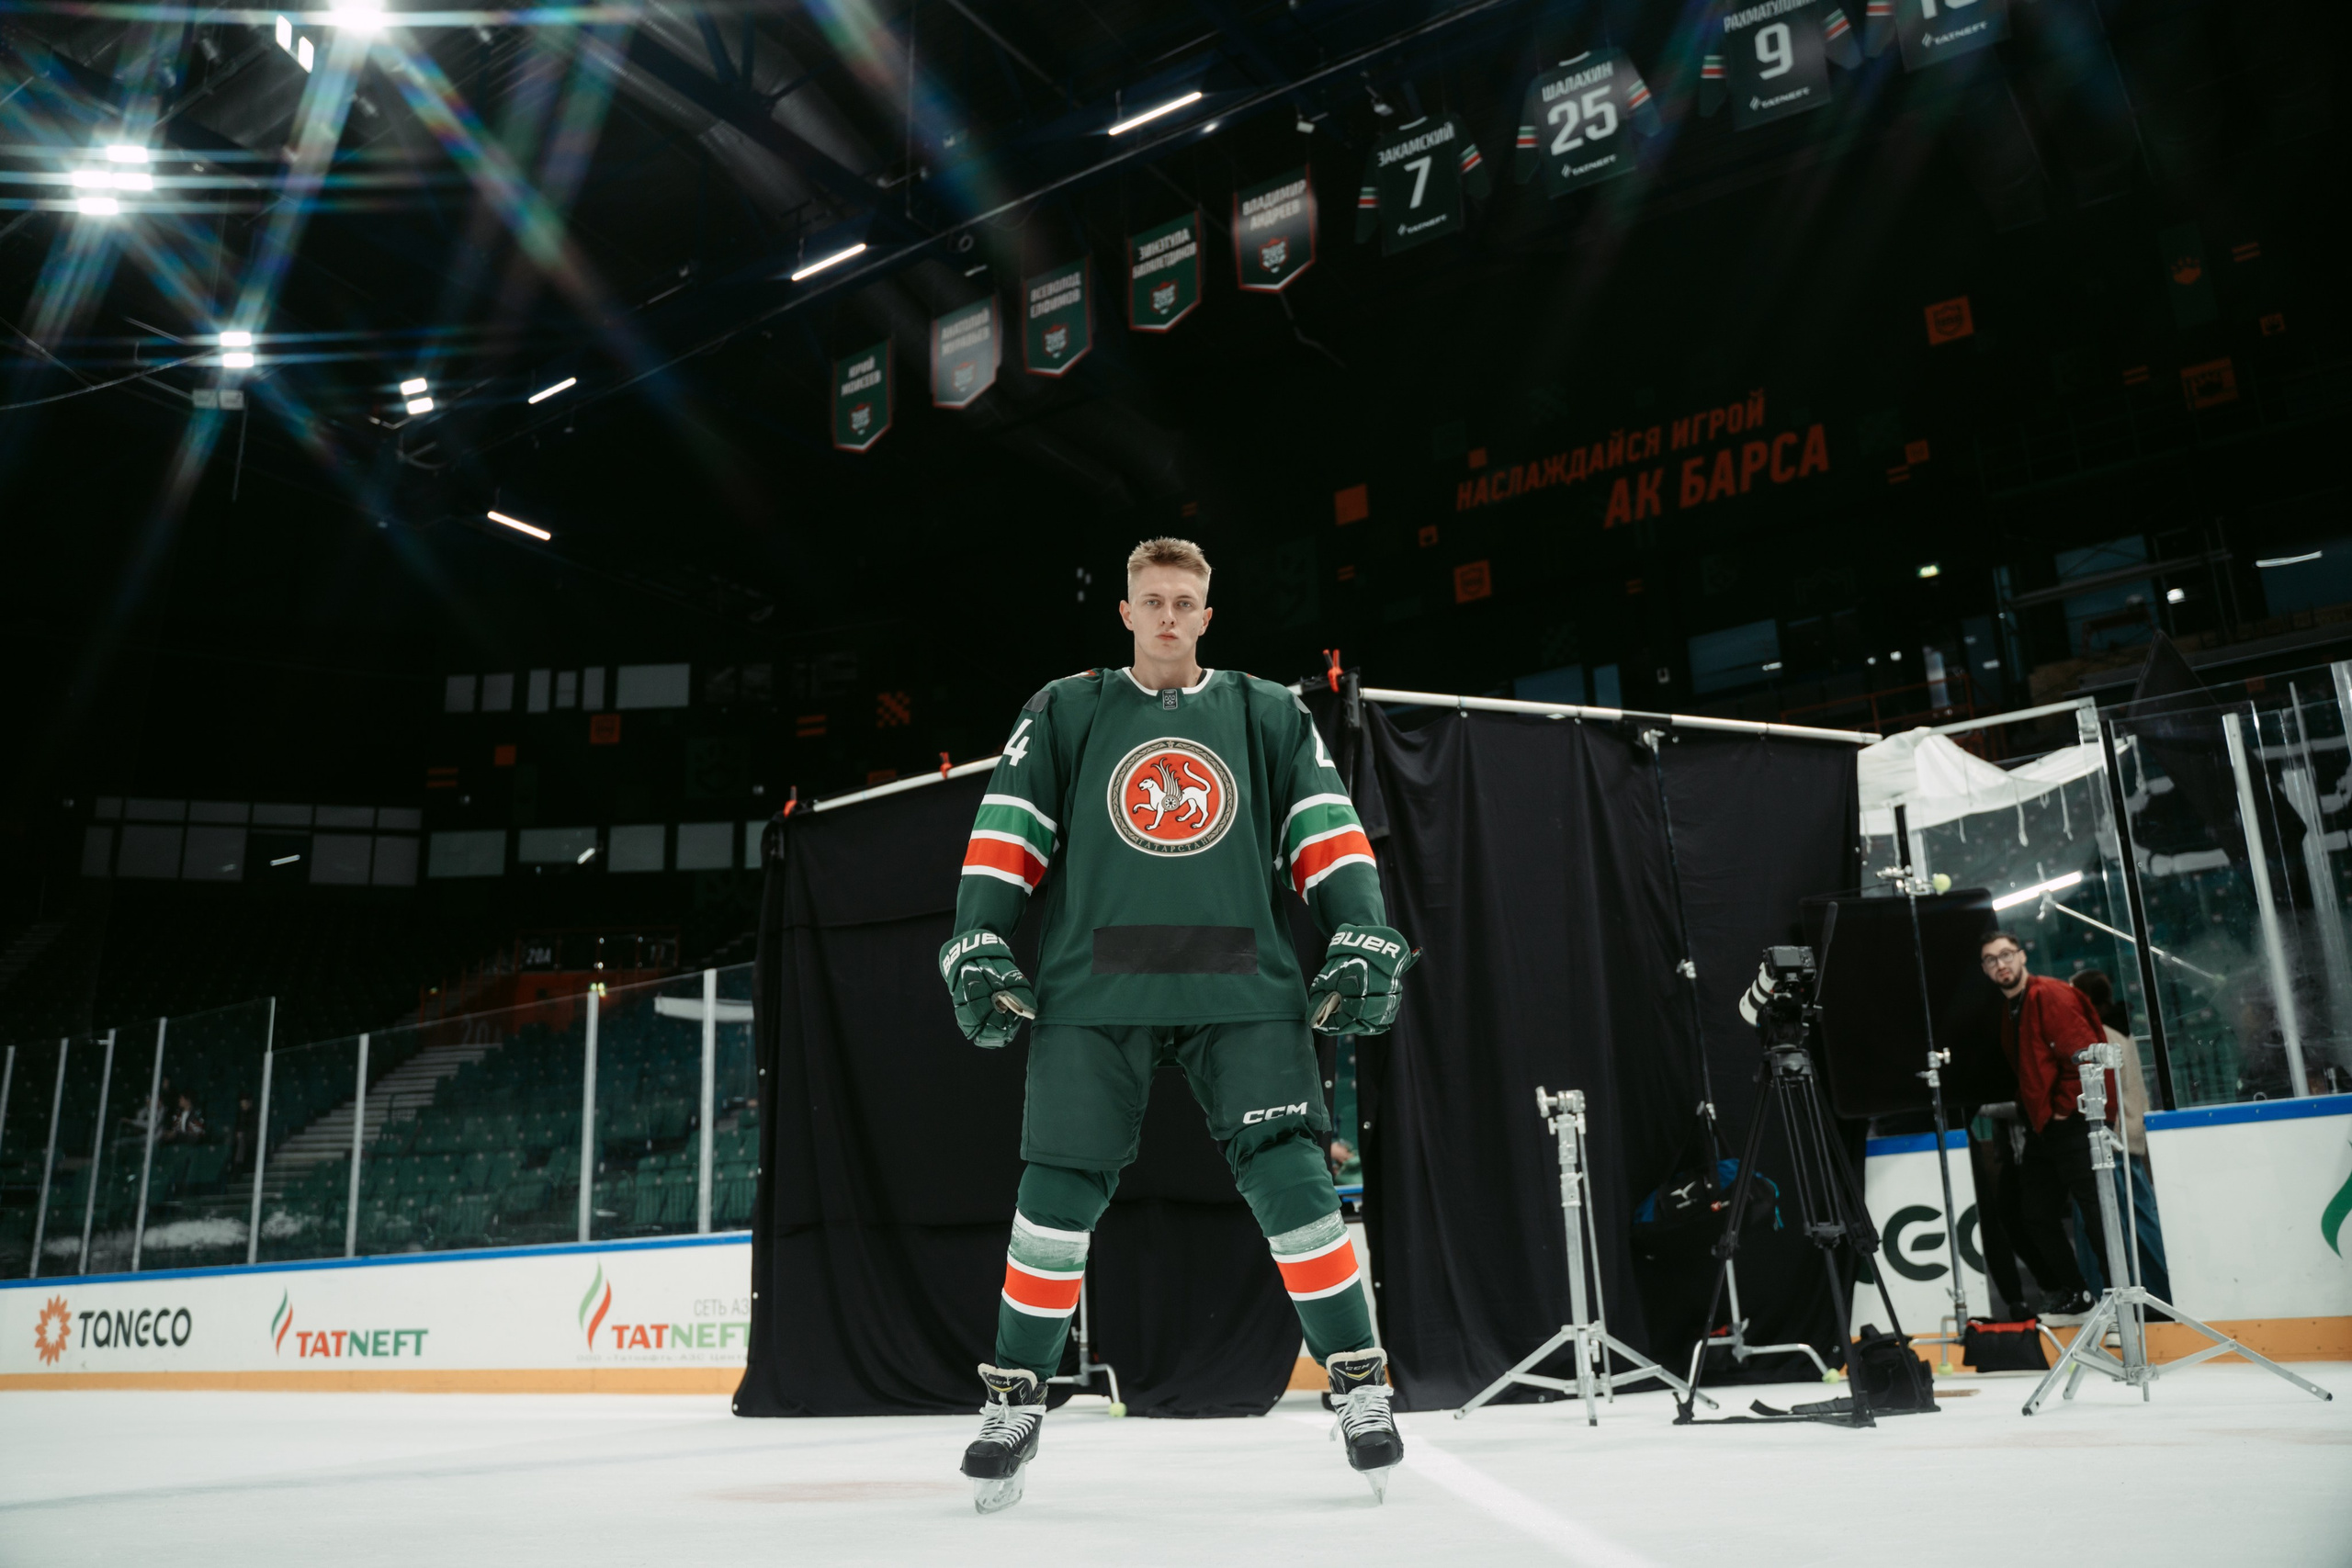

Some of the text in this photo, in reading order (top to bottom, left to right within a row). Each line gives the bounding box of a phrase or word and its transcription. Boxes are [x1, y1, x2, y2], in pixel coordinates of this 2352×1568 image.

[1754, 22, 1793, 80] 9
[1542, 61, 1614, 102] ШАЛАХИН
[1547, 85, 1619, 156] 25
[1377, 121, 1455, 167] ЗАКАМСКИЙ
[1242, 179, 1306, 216] ВЛАДИМИР
[1403, 155, 1432, 209] 7
[1456, 388, 1766, 512] НАСЛАЖДАЙСЯ ИГРОЙ
[1603, 423, 1830, 530] АК БАРСА
[1002, 718, 1034, 767] 4
[1138, 837, 1208, 852] ТАТАРСТАН
[1242, 1101, 1308, 1124] CCM
[79, 1307, 192, 1348] TANECO
[694, 1298, 727, 1316] СЕТЬ
[296, 1328, 429, 1358] TATNEFT
[611, 1323, 751, 1349] TATNEFT
[1345, 1362, 1371, 1371] CCM
